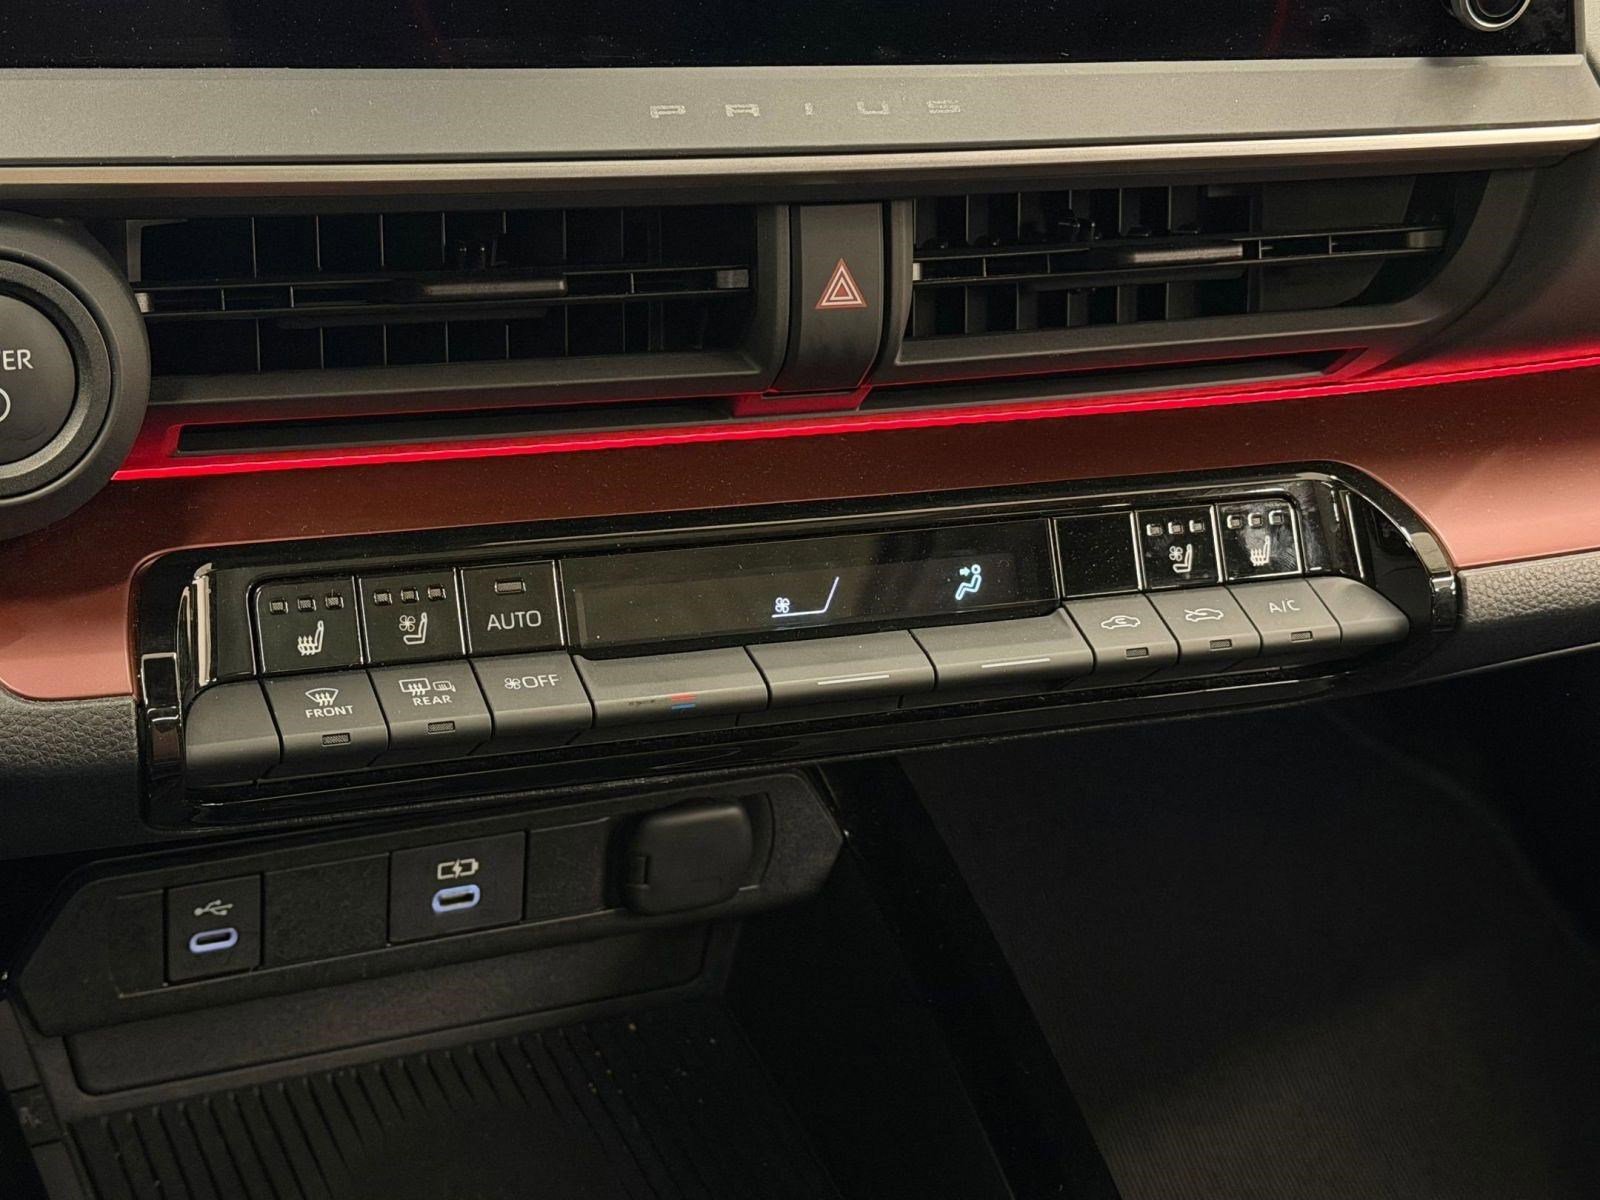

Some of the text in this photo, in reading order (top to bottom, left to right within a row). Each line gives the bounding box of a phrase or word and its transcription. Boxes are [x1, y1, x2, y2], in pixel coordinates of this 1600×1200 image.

[649, 100, 962, 118] PRIUS
[0, 349, 34, 371] ER
[1269, 599, 1301, 613] A/C
[487, 610, 542, 631] AUTO
[523, 674, 559, 690] OFF
[413, 694, 453, 706] REAR
[305, 705, 354, 719] FRONT
